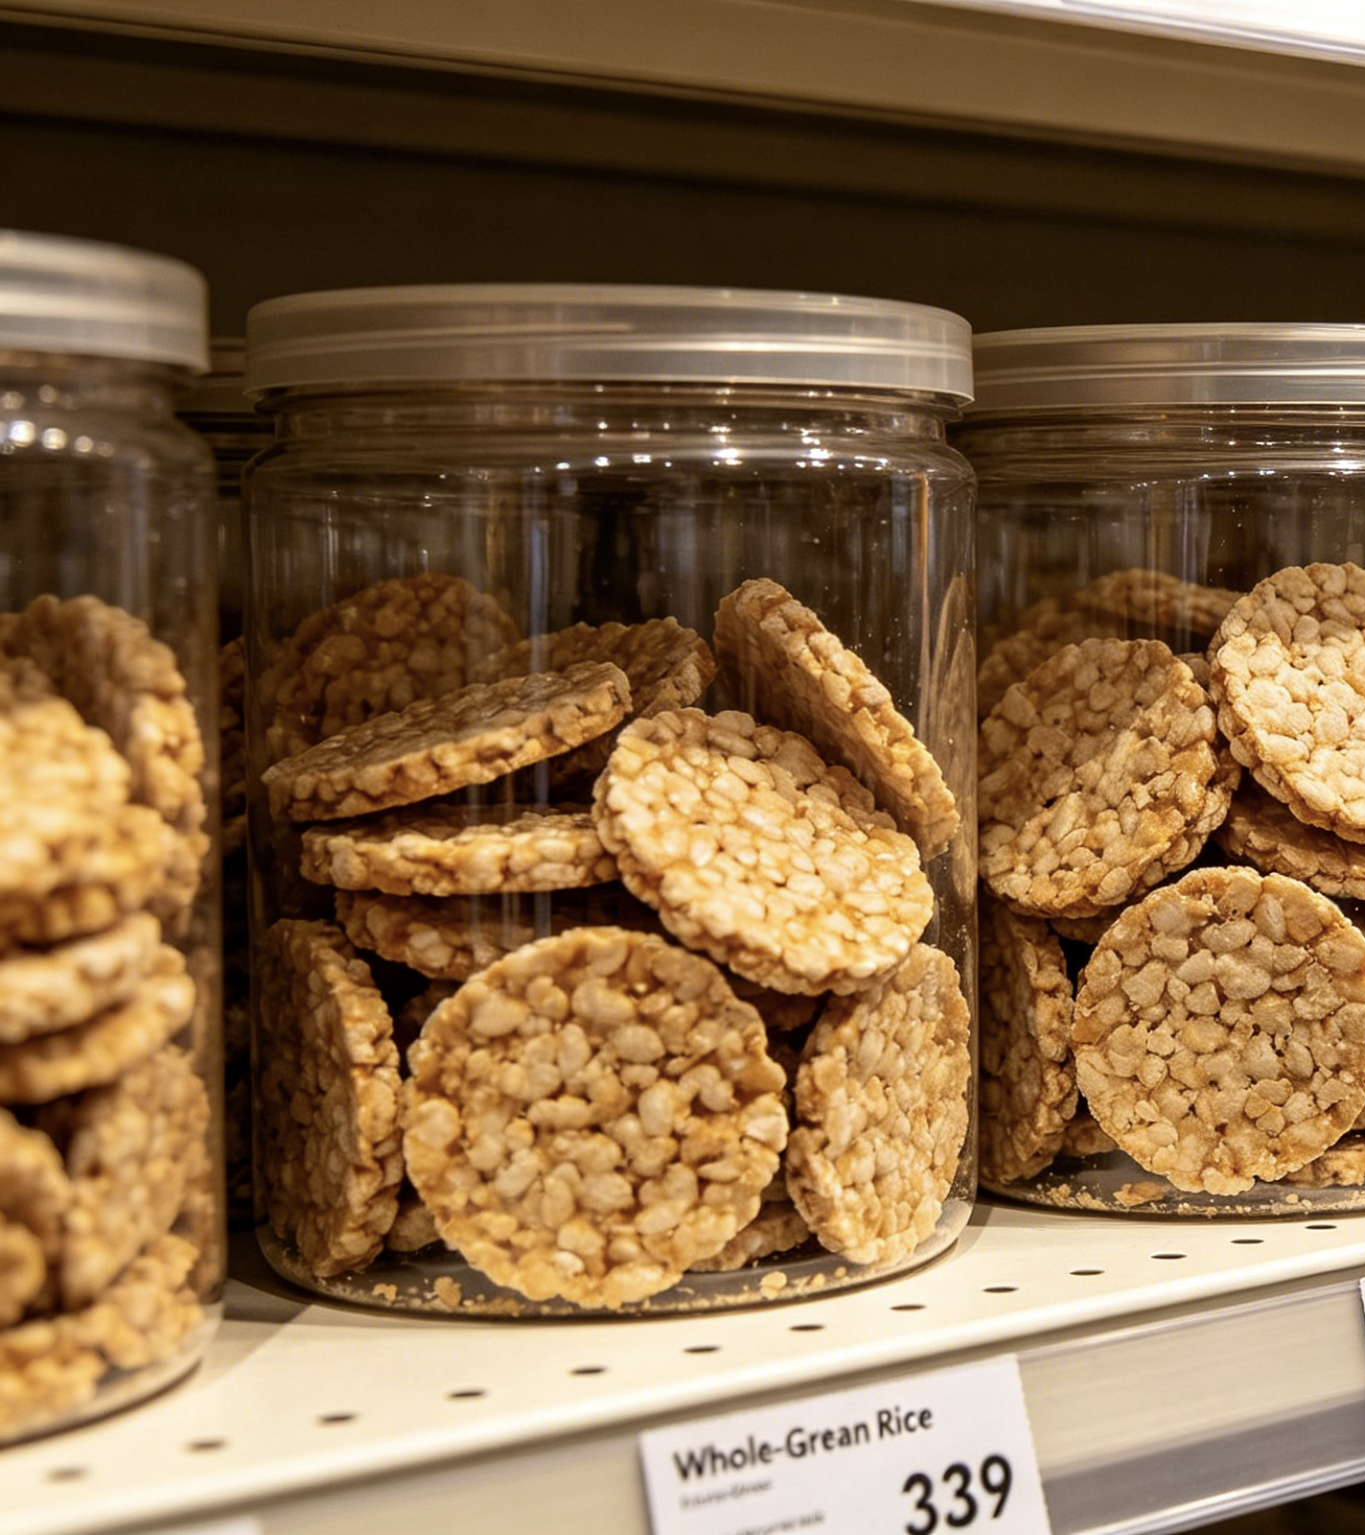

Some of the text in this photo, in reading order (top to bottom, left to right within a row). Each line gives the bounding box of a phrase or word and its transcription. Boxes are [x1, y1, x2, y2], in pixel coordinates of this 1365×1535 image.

[674, 1405, 934, 1480] Whole-Grean Rice
[901, 1454, 1014, 1535] 339
